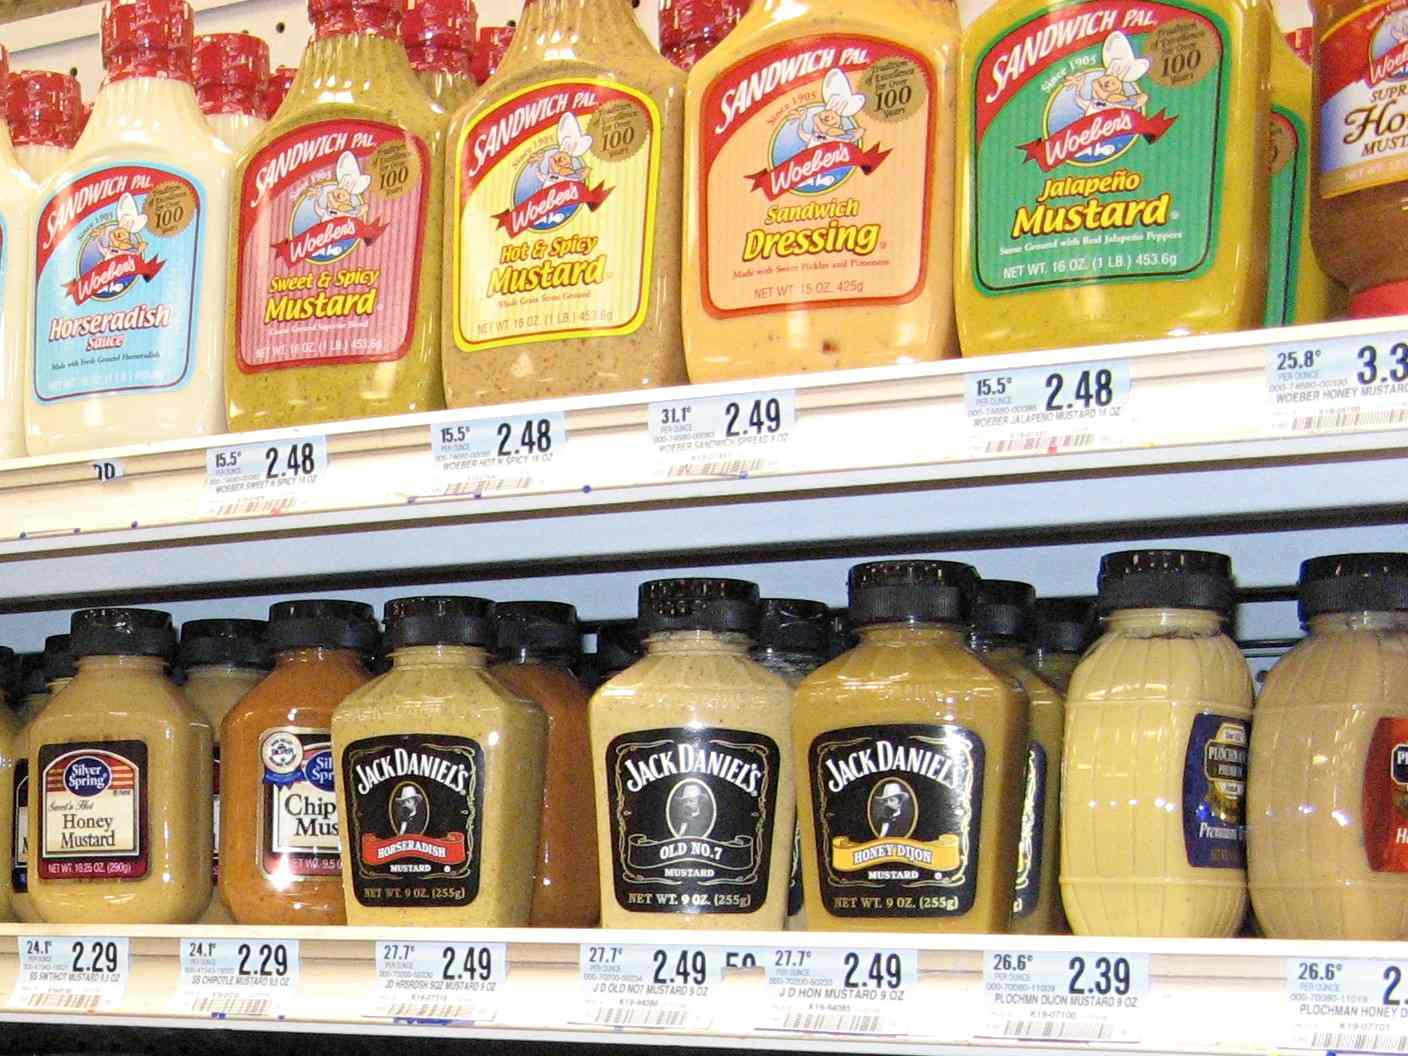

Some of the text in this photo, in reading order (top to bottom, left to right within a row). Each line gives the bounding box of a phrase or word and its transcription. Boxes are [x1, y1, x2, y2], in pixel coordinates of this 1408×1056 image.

[986, 10, 1114, 104] SANDWICH
[1162, 50, 1201, 75] 100
[715, 48, 835, 135] SANDWICH
[875, 86, 913, 111] 100
[469, 91, 567, 177] SANDWICH
[602, 126, 635, 151] 100
[1046, 111, 1133, 166] Woeber's
[251, 131, 348, 207] SANDWICH
[379, 167, 409, 189] 100
[770, 146, 850, 196] Woeber's
[1037, 168, 1141, 201] Jalapeño
[42, 176, 127, 250] SANDWICH
[511, 184, 579, 231] Woeber's
[765, 199, 859, 226] Sandwich
[1011, 194, 1171, 239] Mustard
[289, 221, 357, 262] Woeber's
[500, 235, 598, 265] Hot & Spicy
[743, 222, 881, 263] Dressing
[270, 267, 379, 292] Sweet & Spicy
[487, 256, 606, 298] Mustard
[1003, 266, 1024, 279] NET
[1052, 261, 1066, 273] 16
[1135, 253, 1177, 267] 453.6g
[49, 304, 172, 342] Horseradish
[264, 289, 375, 325] Mustard
[86, 333, 124, 351] Sauce
[1044, 369, 1114, 412] 2.48
[1276, 391, 1320, 404] WOEBER
[1322, 387, 1358, 400] HONEY
[724, 398, 782, 438] 2.49
[497, 419, 552, 456] 2.48
[265, 442, 315, 480] 2.48
[68, 774, 105, 790] Spring
[70, 763, 101, 778] Silver
[357, 748, 467, 796] JACK DANIEL'S
[625, 742, 762, 794] JACK DANIEL'S
[825, 748, 877, 793] JACK
[63, 814, 113, 832] Honey
[60, 831, 116, 849] Mustard
[377, 842, 448, 860] HORSERADISH
[659, 843, 688, 860] OLD
[853, 844, 934, 865] HONEY DIJON
[390, 863, 432, 874] MUSTARD
[664, 868, 715, 879] MUSTARD
[868, 869, 920, 881] MUSTARD
[71, 941, 118, 972] 2.29
[238, 943, 288, 975] 2.29
[442, 947, 492, 980] 2.49
[653, 950, 707, 985] 2.49
[843, 952, 902, 989] 2.49
[1068, 957, 1131, 995] 2.39
[797, 989, 821, 999] HON
[824, 989, 878, 1000] MUSTARD
[890, 990, 905, 1001] OZ
[1070, 996, 1115, 1007] MUSTARD
[1124, 998, 1138, 1008] OZ
[1300, 1004, 1397, 1018] PLOCHMAN HONEY
